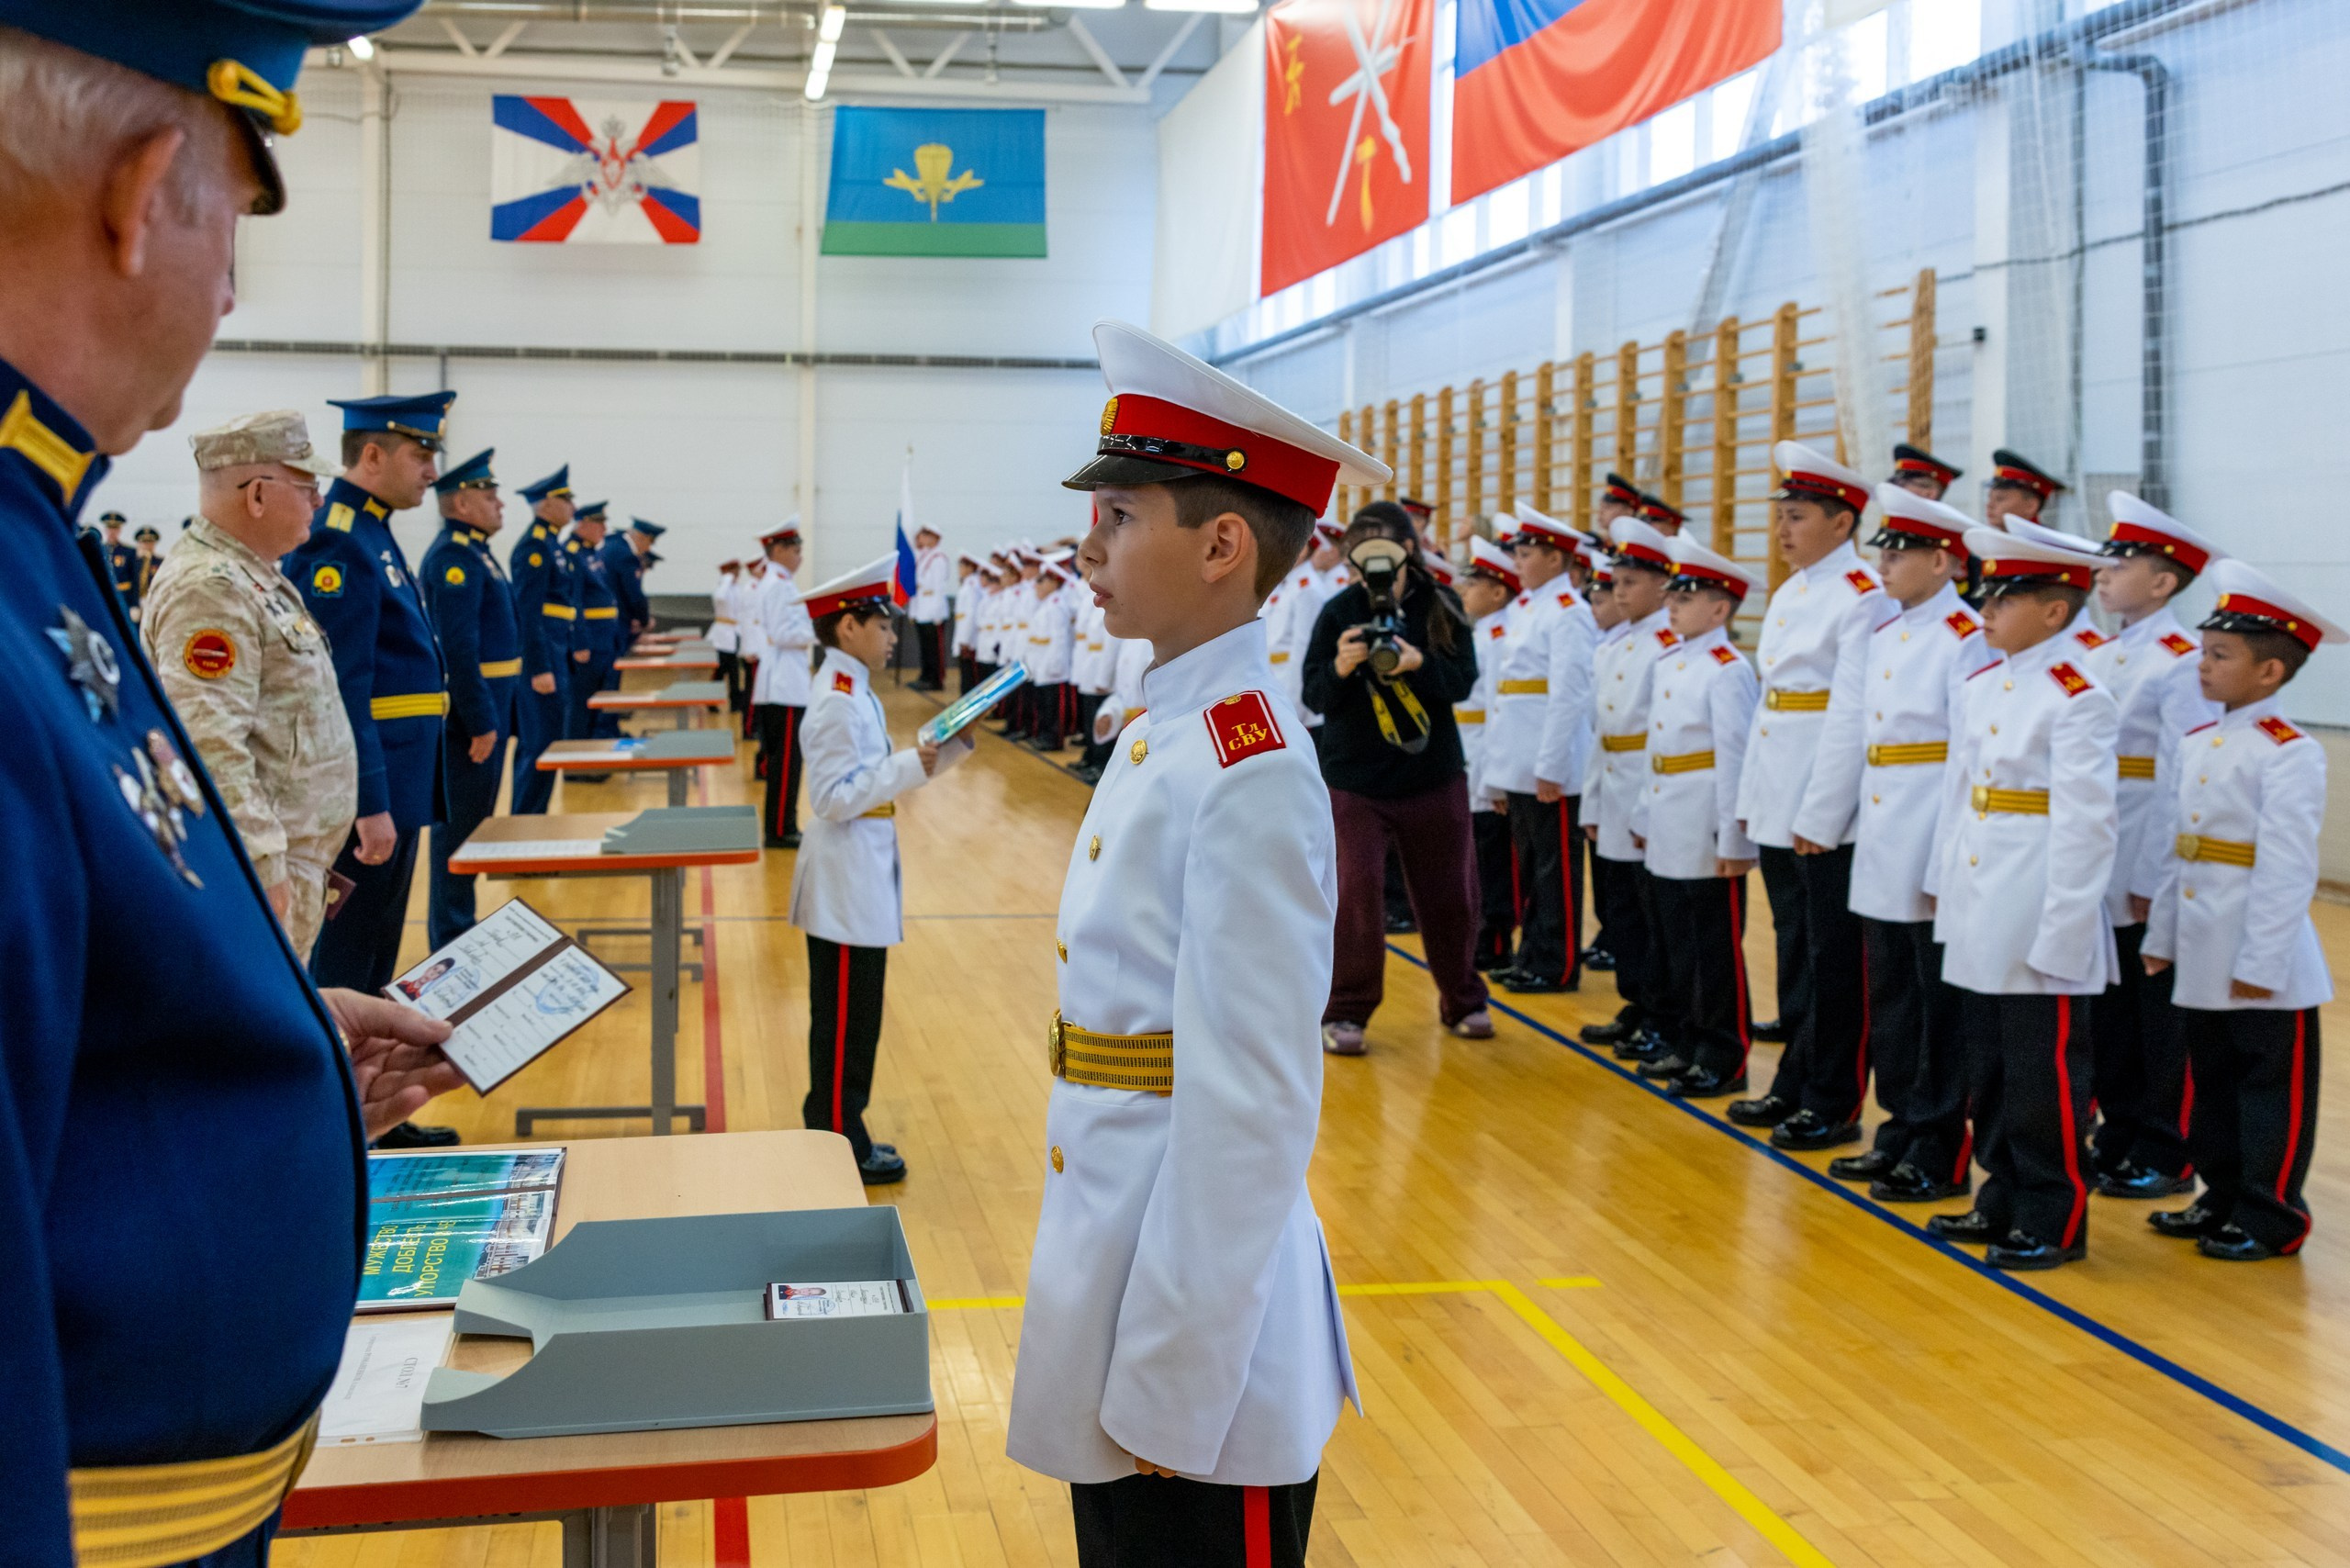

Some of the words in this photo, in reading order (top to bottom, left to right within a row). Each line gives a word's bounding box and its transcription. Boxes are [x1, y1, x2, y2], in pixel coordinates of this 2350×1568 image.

[1228, 728, 1267, 751] СВУ
[1231, 722, 1259, 736] Тл
[363, 1225, 398, 1275] МУЖЕСТВО
[392, 1224, 426, 1273] ДОБЛЕСТЬ
[414, 1238, 449, 1297] УПОРСТВО
